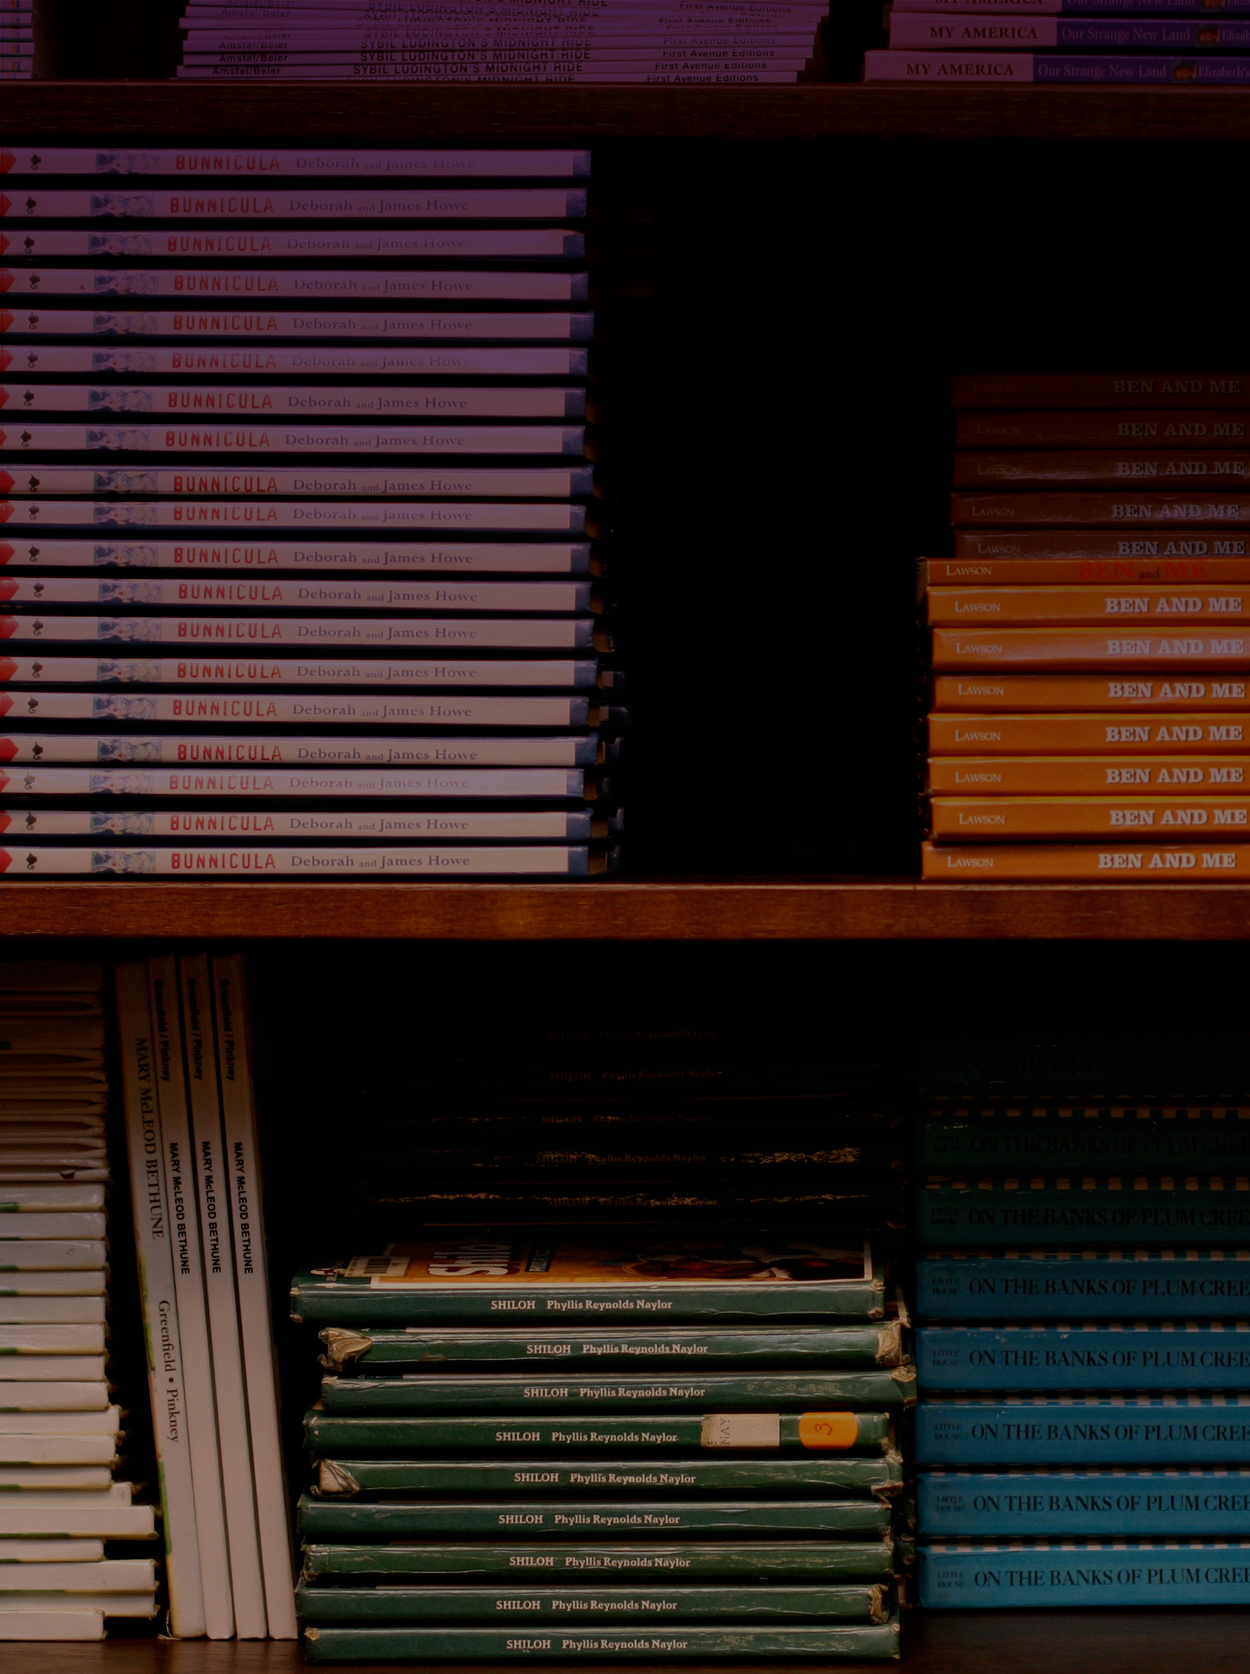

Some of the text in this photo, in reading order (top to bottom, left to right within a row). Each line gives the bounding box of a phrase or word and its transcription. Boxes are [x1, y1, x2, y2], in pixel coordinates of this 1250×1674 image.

[930, 26, 955, 39] MY
[961, 27, 1039, 40] AMERICA
[1062, 28, 1086, 41] Our
[1088, 28, 1130, 44] Strange
[1133, 28, 1160, 41] New
[1162, 28, 1191, 41] Land
[219, 52, 289, 63] Amstel/Beier
[360, 49, 591, 62] SYBIL LUDINGTON'S MIDNIGHT RIDE
[662, 49, 776, 58] First Avenue Editions
[213, 66, 281, 76] Amstel/Beier
[353, 62, 583, 75] SYBIL LUDINGTON'S MIDNIGHT RIDE
[655, 61, 767, 70] First Avenue Editions
[906, 63, 931, 76] MY
[937, 64, 1015, 77] AMERICA
[1038, 64, 1062, 77] Our
[1064, 64, 1107, 80] Strange
[1109, 65, 1136, 78] New
[1138, 64, 1167, 78] Land
[1198, 66, 1250, 78] Elizabeth's
[646, 73, 759, 83] First Avenue Editions
[173, 475, 473, 494] BUNNICULA Deborah and James Howe
[174, 547, 474, 566] BUNNICULA Deborah and James Howe
[1078, 561, 1133, 580] BEN
[1139, 568, 1160, 580] and
[1164, 561, 1209, 580] ME
[1104, 597, 1150, 614] BEN
[1154, 597, 1204, 614] AND
[1207, 597, 1242, 614] ME
[160, 1040, 170, 1082] Pinkney
[193, 1040, 204, 1081] Pinkney
[220, 978, 254, 1274] Greenfield Pinkney MARY McLEOD BETHUNE
[169, 1142, 180, 1173] MARY
[202, 1141, 212, 1172] MARY
[172, 1175, 185, 1220] McLEOD
[205, 1175, 217, 1220] McLEOD
[134, 1037, 180, 1444] MARY McLEOD BETHUNE Greenfield Pinkney
[176, 1223, 190, 1274] BETHUNE
[208, 1222, 222, 1273] BETHUNE
[491, 1299, 673, 1312] SHILOH Phyllis Reynolds Naylor
[495, 1431, 678, 1444] SHILOH Phyllis Reynolds Naylor
[974, 1570, 1001, 1588] ON
[1005, 1570, 1045, 1587] THE
[1050, 1569, 1113, 1587] BANKS
[1117, 1569, 1143, 1587] OF
[1147, 1568, 1201, 1586] PLUM
